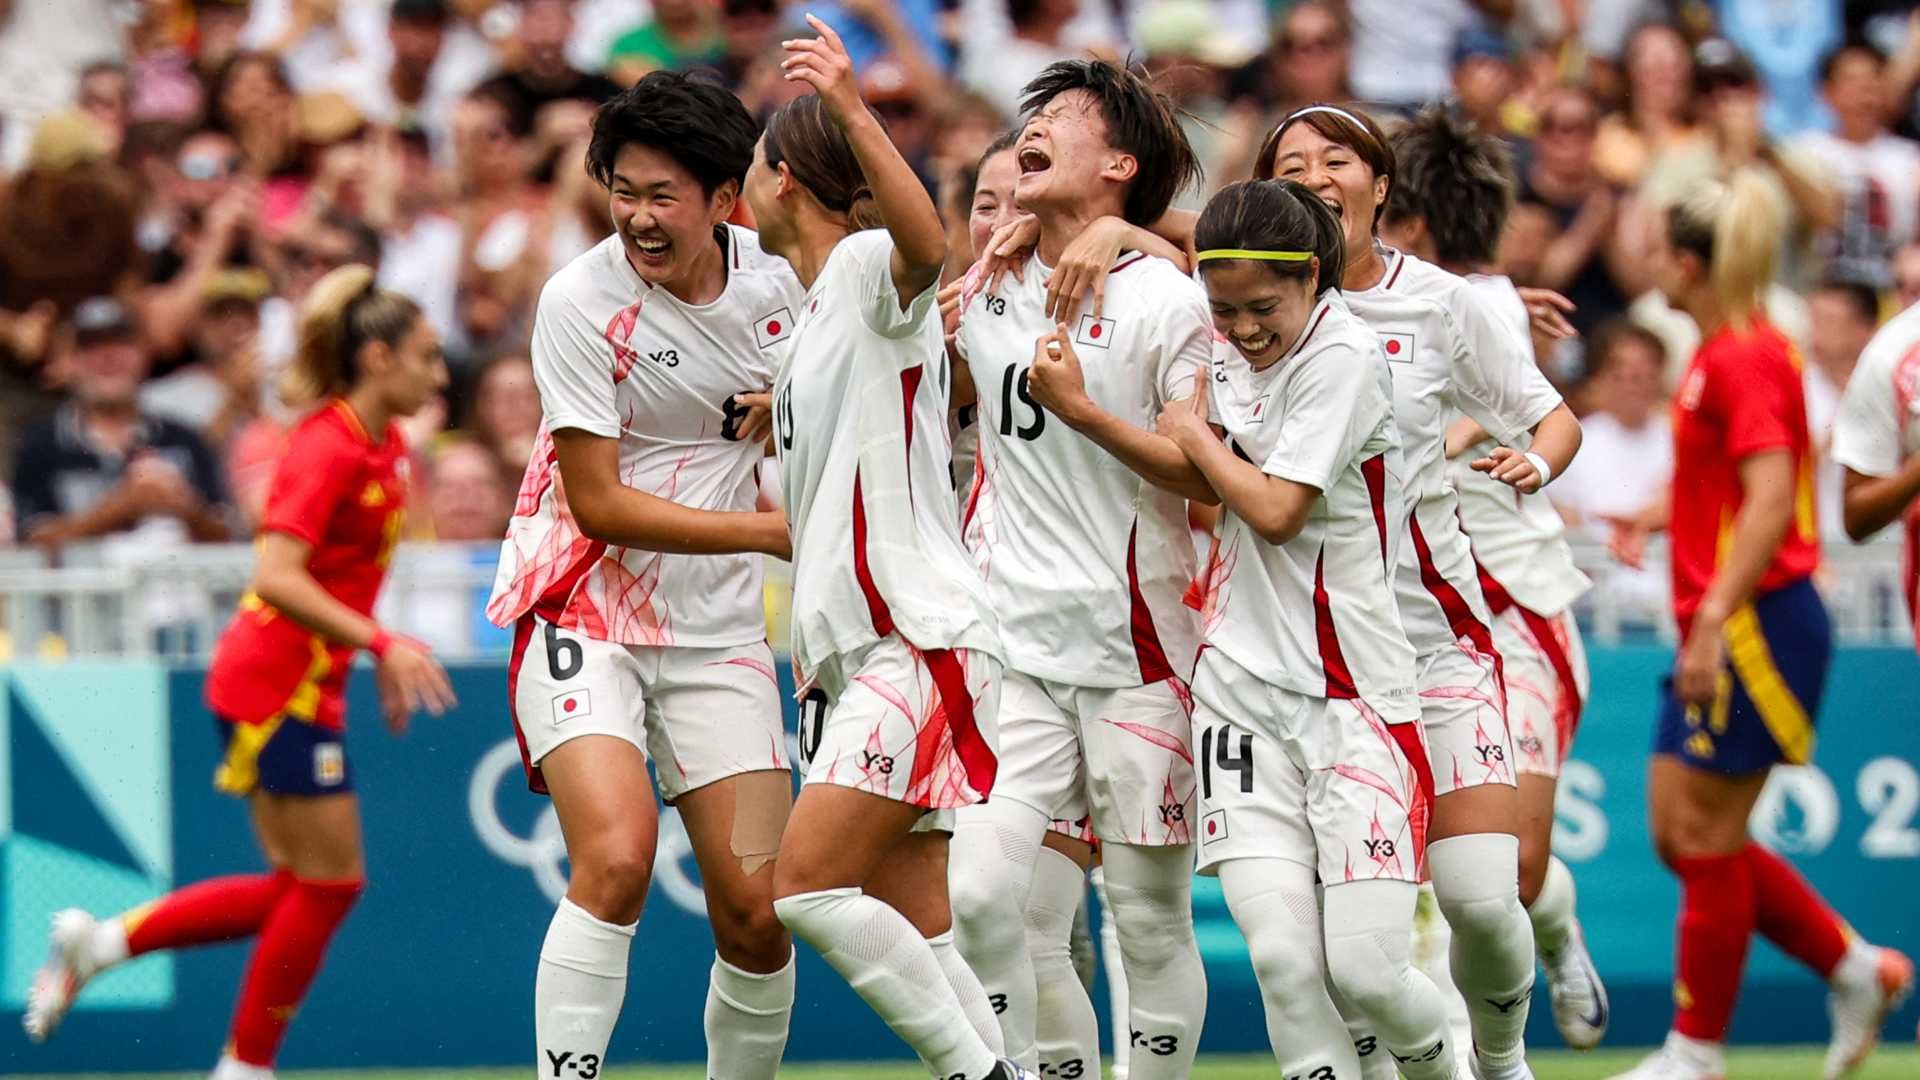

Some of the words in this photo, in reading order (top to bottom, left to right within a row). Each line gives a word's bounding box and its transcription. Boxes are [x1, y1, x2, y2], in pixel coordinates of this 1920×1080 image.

[984, 293, 1006, 316] Y-3
[544, 623, 584, 681] 6
[862, 749, 895, 774] Y-3
[1201, 724, 1253, 800] 14
[1475, 744, 1505, 762] Y-3
[1159, 803, 1185, 822] Y-3
[1363, 838, 1396, 857] Y-3
[545, 1049, 600, 1080] Y-3
